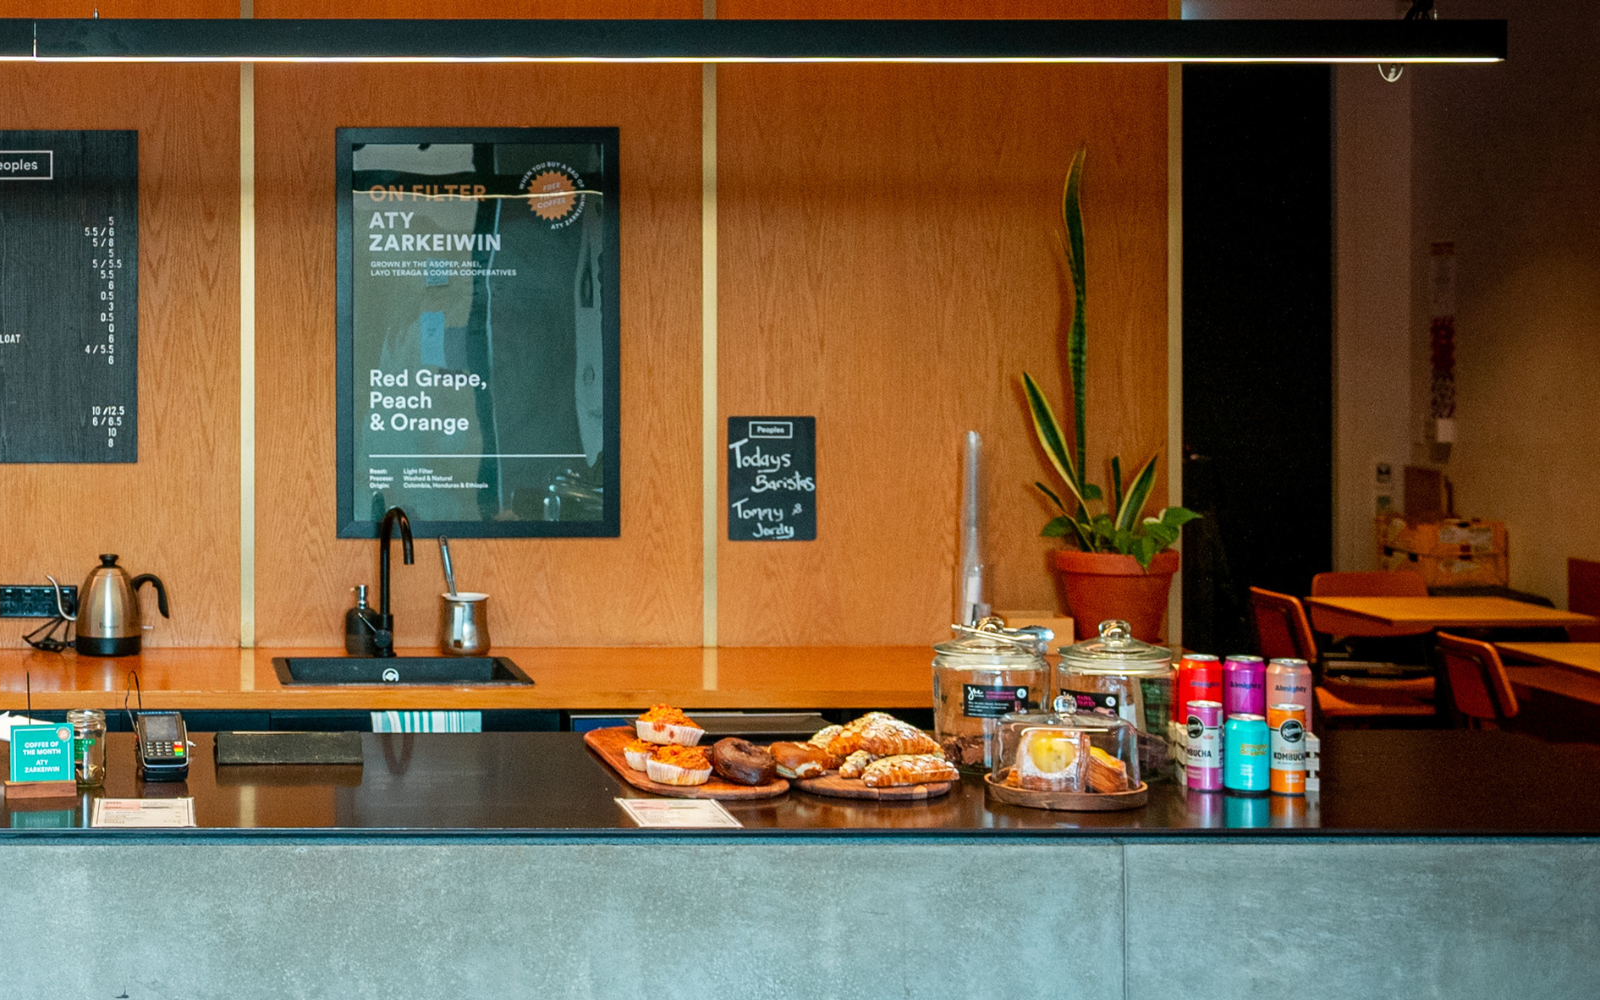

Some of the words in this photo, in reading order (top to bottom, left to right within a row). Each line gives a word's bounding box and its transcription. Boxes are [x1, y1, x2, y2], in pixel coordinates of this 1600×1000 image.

[532, 162, 546, 172] YOU
[567, 166, 579, 179] BAG
[577, 178, 585, 188] OF
[543, 182, 561, 191] FREE
[369, 184, 404, 202] ON
[412, 184, 486, 202] FILTER
[537, 198, 566, 209] COFFEE
[108, 216, 114, 226] 5
[369, 212, 414, 229] ATY
[85, 227, 98, 236] 5.5
[109, 227, 114, 236] 6
[93, 238, 98, 247] 5
[109, 238, 114, 247] 8
[369, 234, 501, 252] ZARKEIWIN
[109, 249, 114, 258] 5
[93, 259, 98, 268] 5
[109, 259, 122, 268] 5.5
[100, 270, 114, 279] 5.5
[109, 280, 114, 290] 6
[100, 291, 114, 301] 0.5
[108, 302, 114, 311] 3
[100, 312, 114, 322] 0.5
[109, 323, 114, 333] 0
[108, 334, 114, 343] 6
[85, 344, 90, 354] 4
[100, 344, 114, 354] 5.5
[108, 355, 114, 365] 6
[370, 369, 409, 387] Red
[415, 369, 487, 390] Grape,
[370, 391, 432, 409] Peach
[92, 406, 101, 416] 10
[93, 417, 98, 426] 6
[370, 413, 385, 431] &
[390, 413, 469, 435] Orange
[108, 428, 117, 437] 10
[757, 426, 784, 434] Peoples
[108, 438, 114, 448] 8
[728, 438, 792, 473] Todays
[750, 470, 815, 493] Baristas
[732, 497, 784, 522] Tommy
[752, 522, 794, 540] Jordy
[1230, 681, 1261, 690] Almighty
[1275, 685, 1307, 693] Almighty
